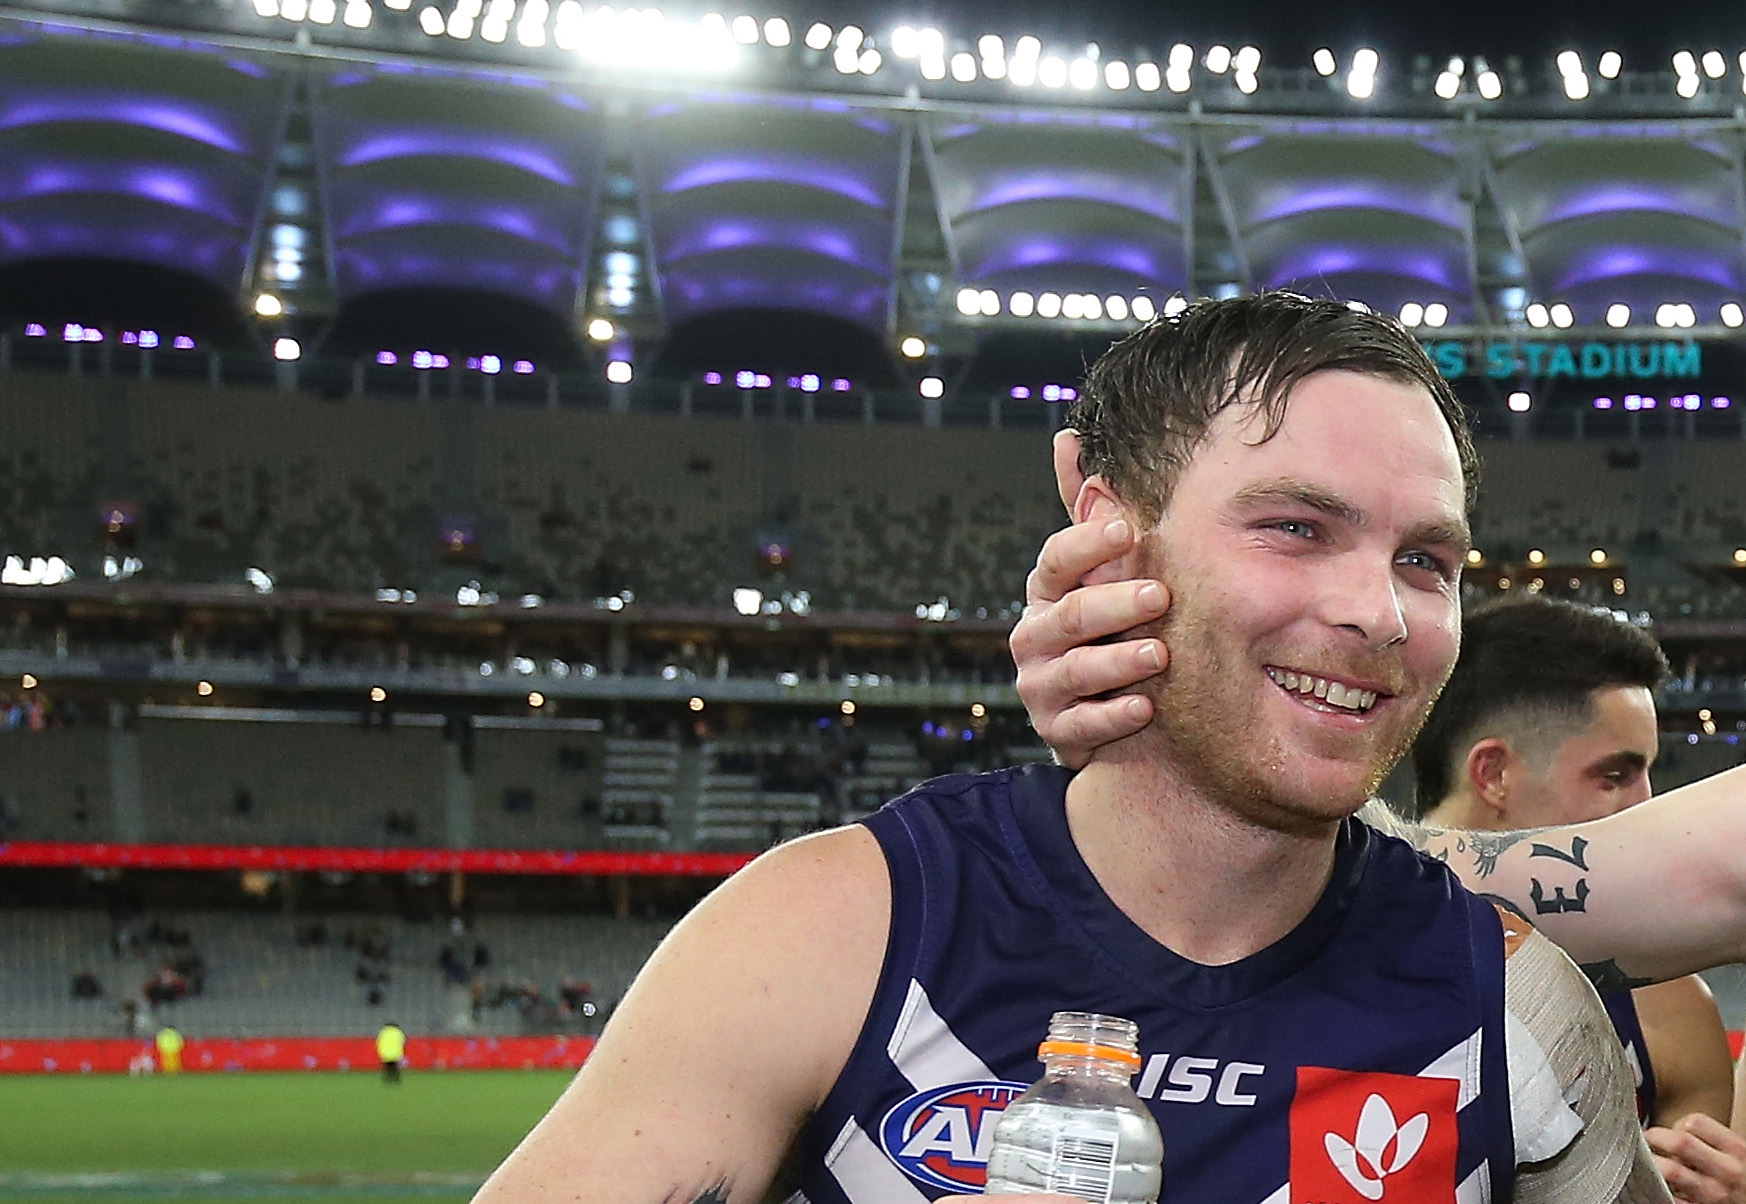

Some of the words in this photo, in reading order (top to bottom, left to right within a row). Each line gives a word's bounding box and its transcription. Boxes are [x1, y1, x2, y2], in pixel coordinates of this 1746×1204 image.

[1423, 343, 1466, 378] S
[1486, 343, 1701, 378] STADIUM
[1136, 1053, 1265, 1107] ISC
